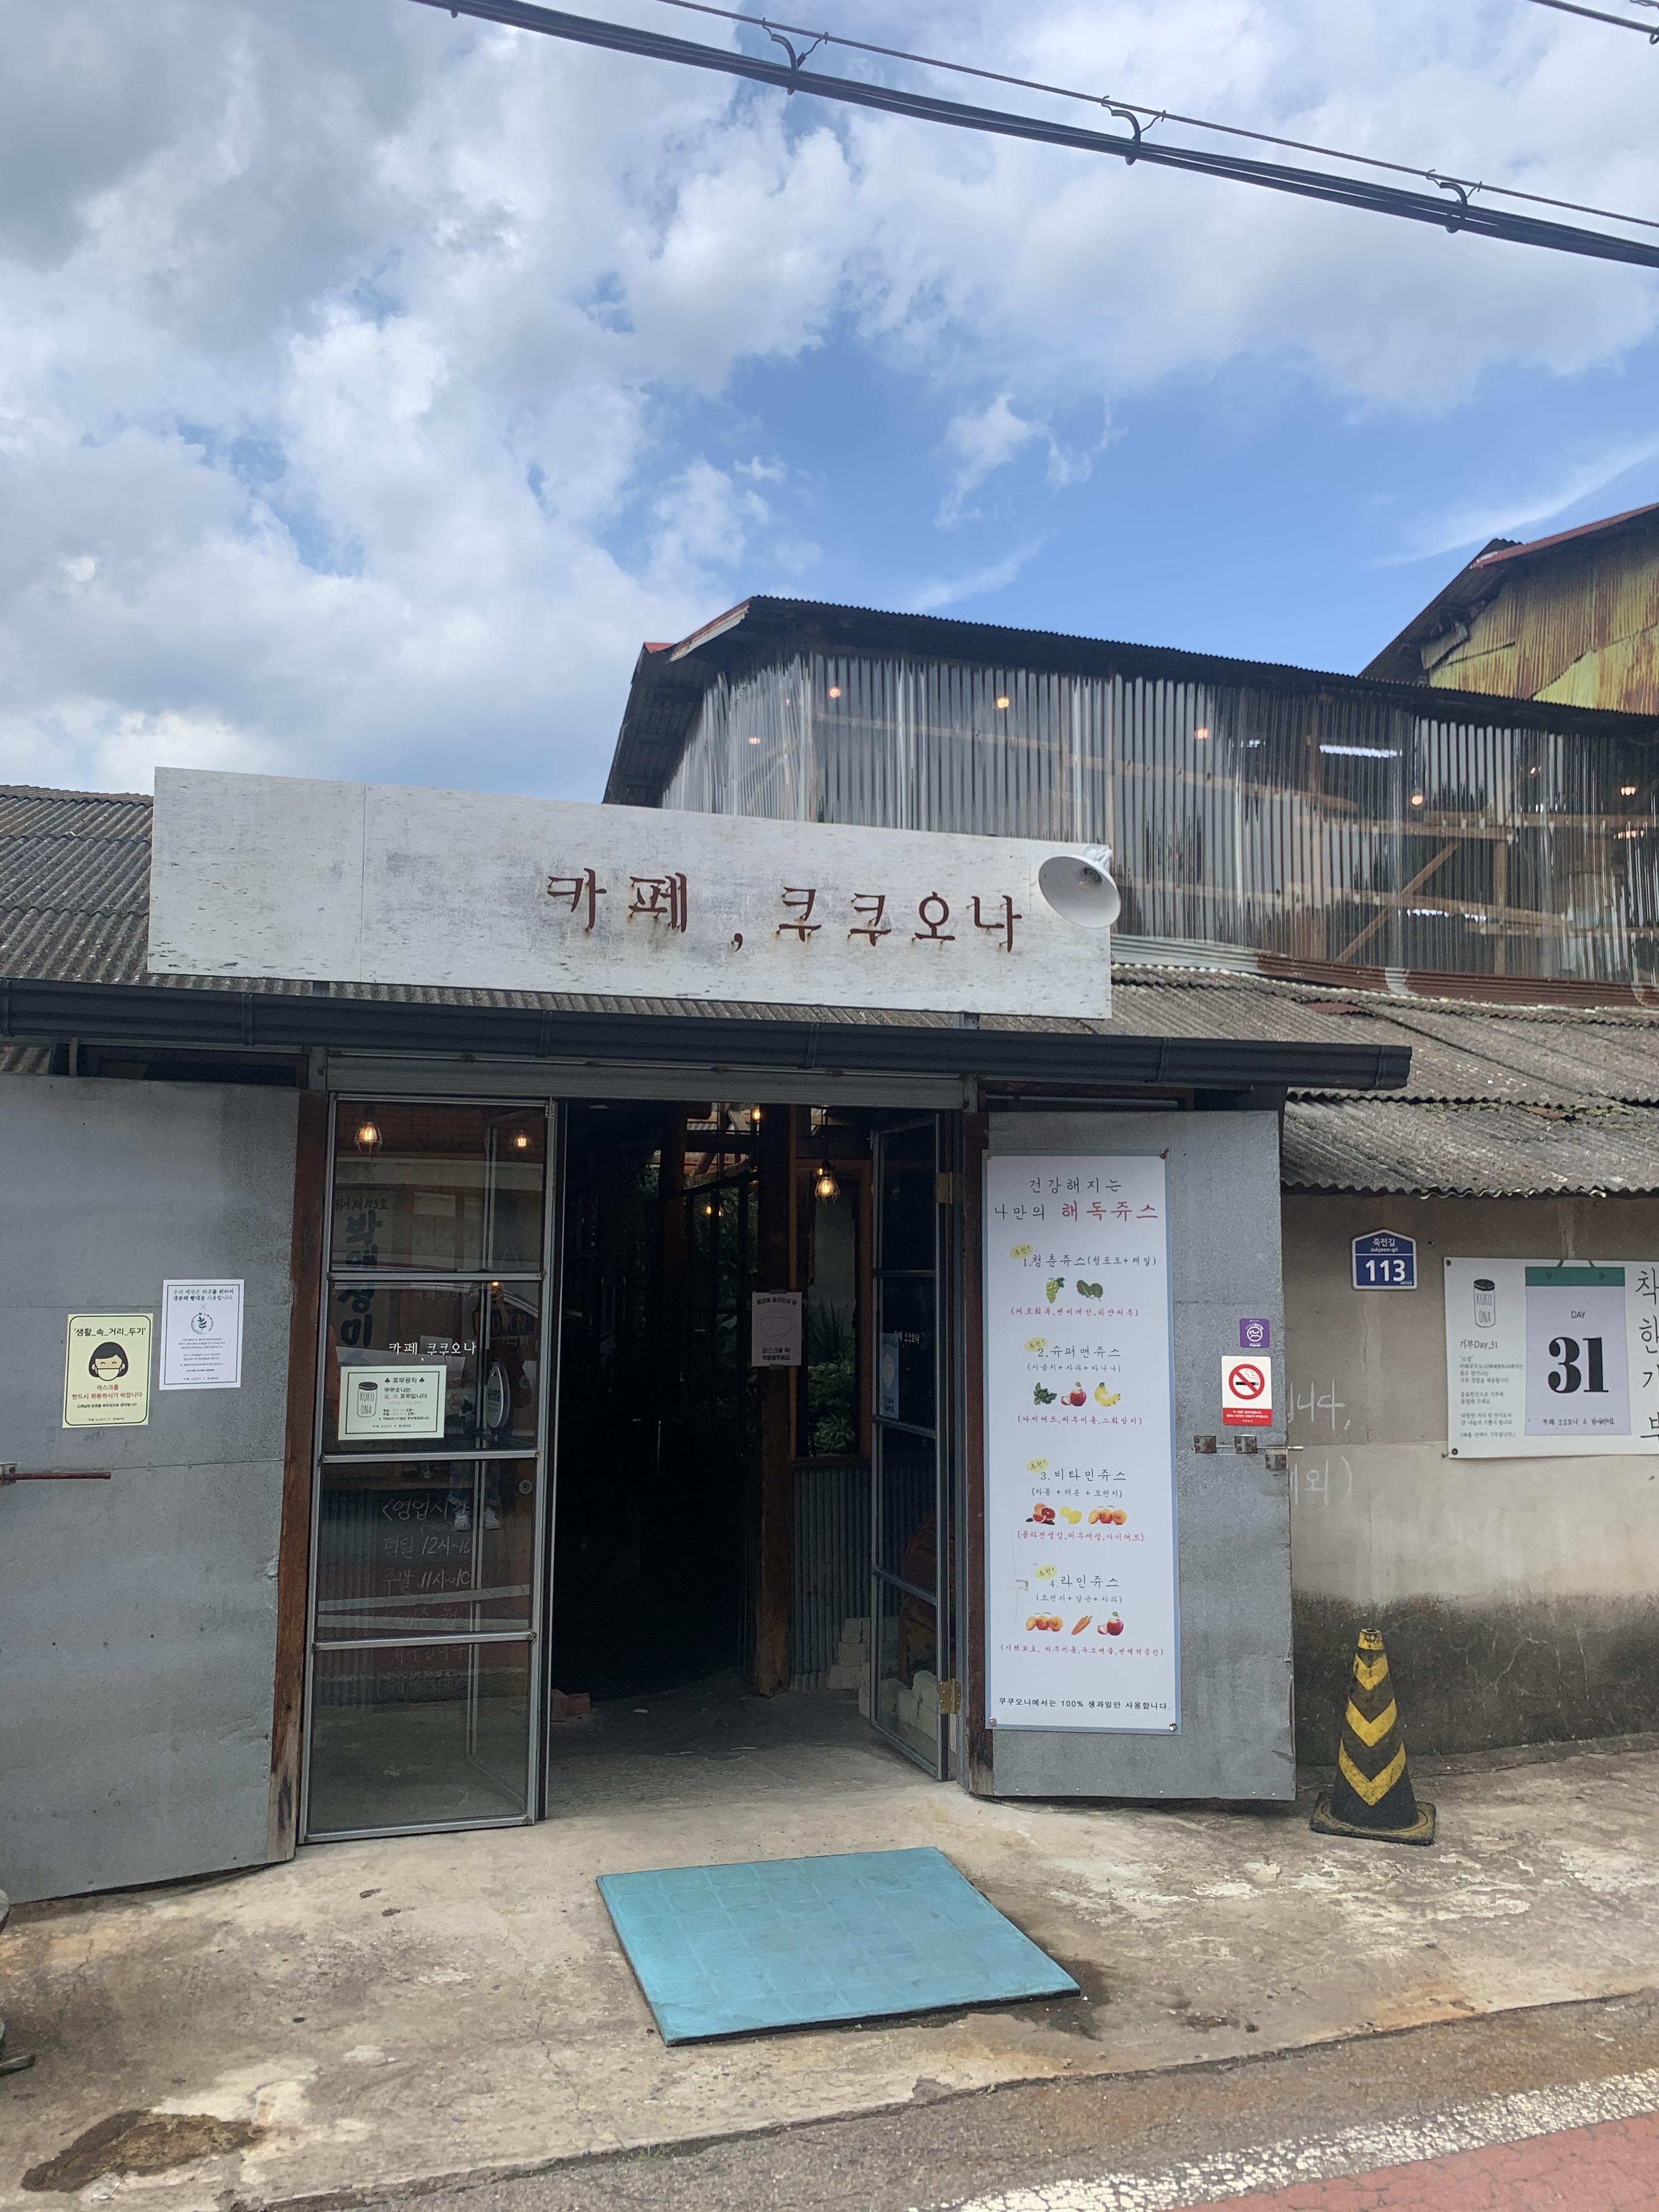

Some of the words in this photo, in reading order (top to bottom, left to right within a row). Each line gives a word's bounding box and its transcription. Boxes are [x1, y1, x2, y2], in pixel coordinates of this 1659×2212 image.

[775, 886, 1023, 952] 쿠쿠오나
[1030, 1177, 1121, 1194] 건강해지는
[995, 1204, 1045, 1220] 나만의
[1062, 1200, 1158, 1222] 해독쥬스
[1365, 1259, 1406, 1282] 113
[1476, 1293, 1492, 1306] KUKU
[1479, 1311, 1491, 1323] ONA
[426, 1341, 477, 1356] 쿠쿠오나
[1548, 1336, 1609, 1394] 31
[360, 1391, 374, 1402] KUKU
[360, 1405, 372, 1414] ONA
[998, 1697, 1057, 1707] 쿠쿠오나에서는
[1061, 1700, 1084, 1708] 100%
[1088, 1700, 1121, 1709] 생과일만
